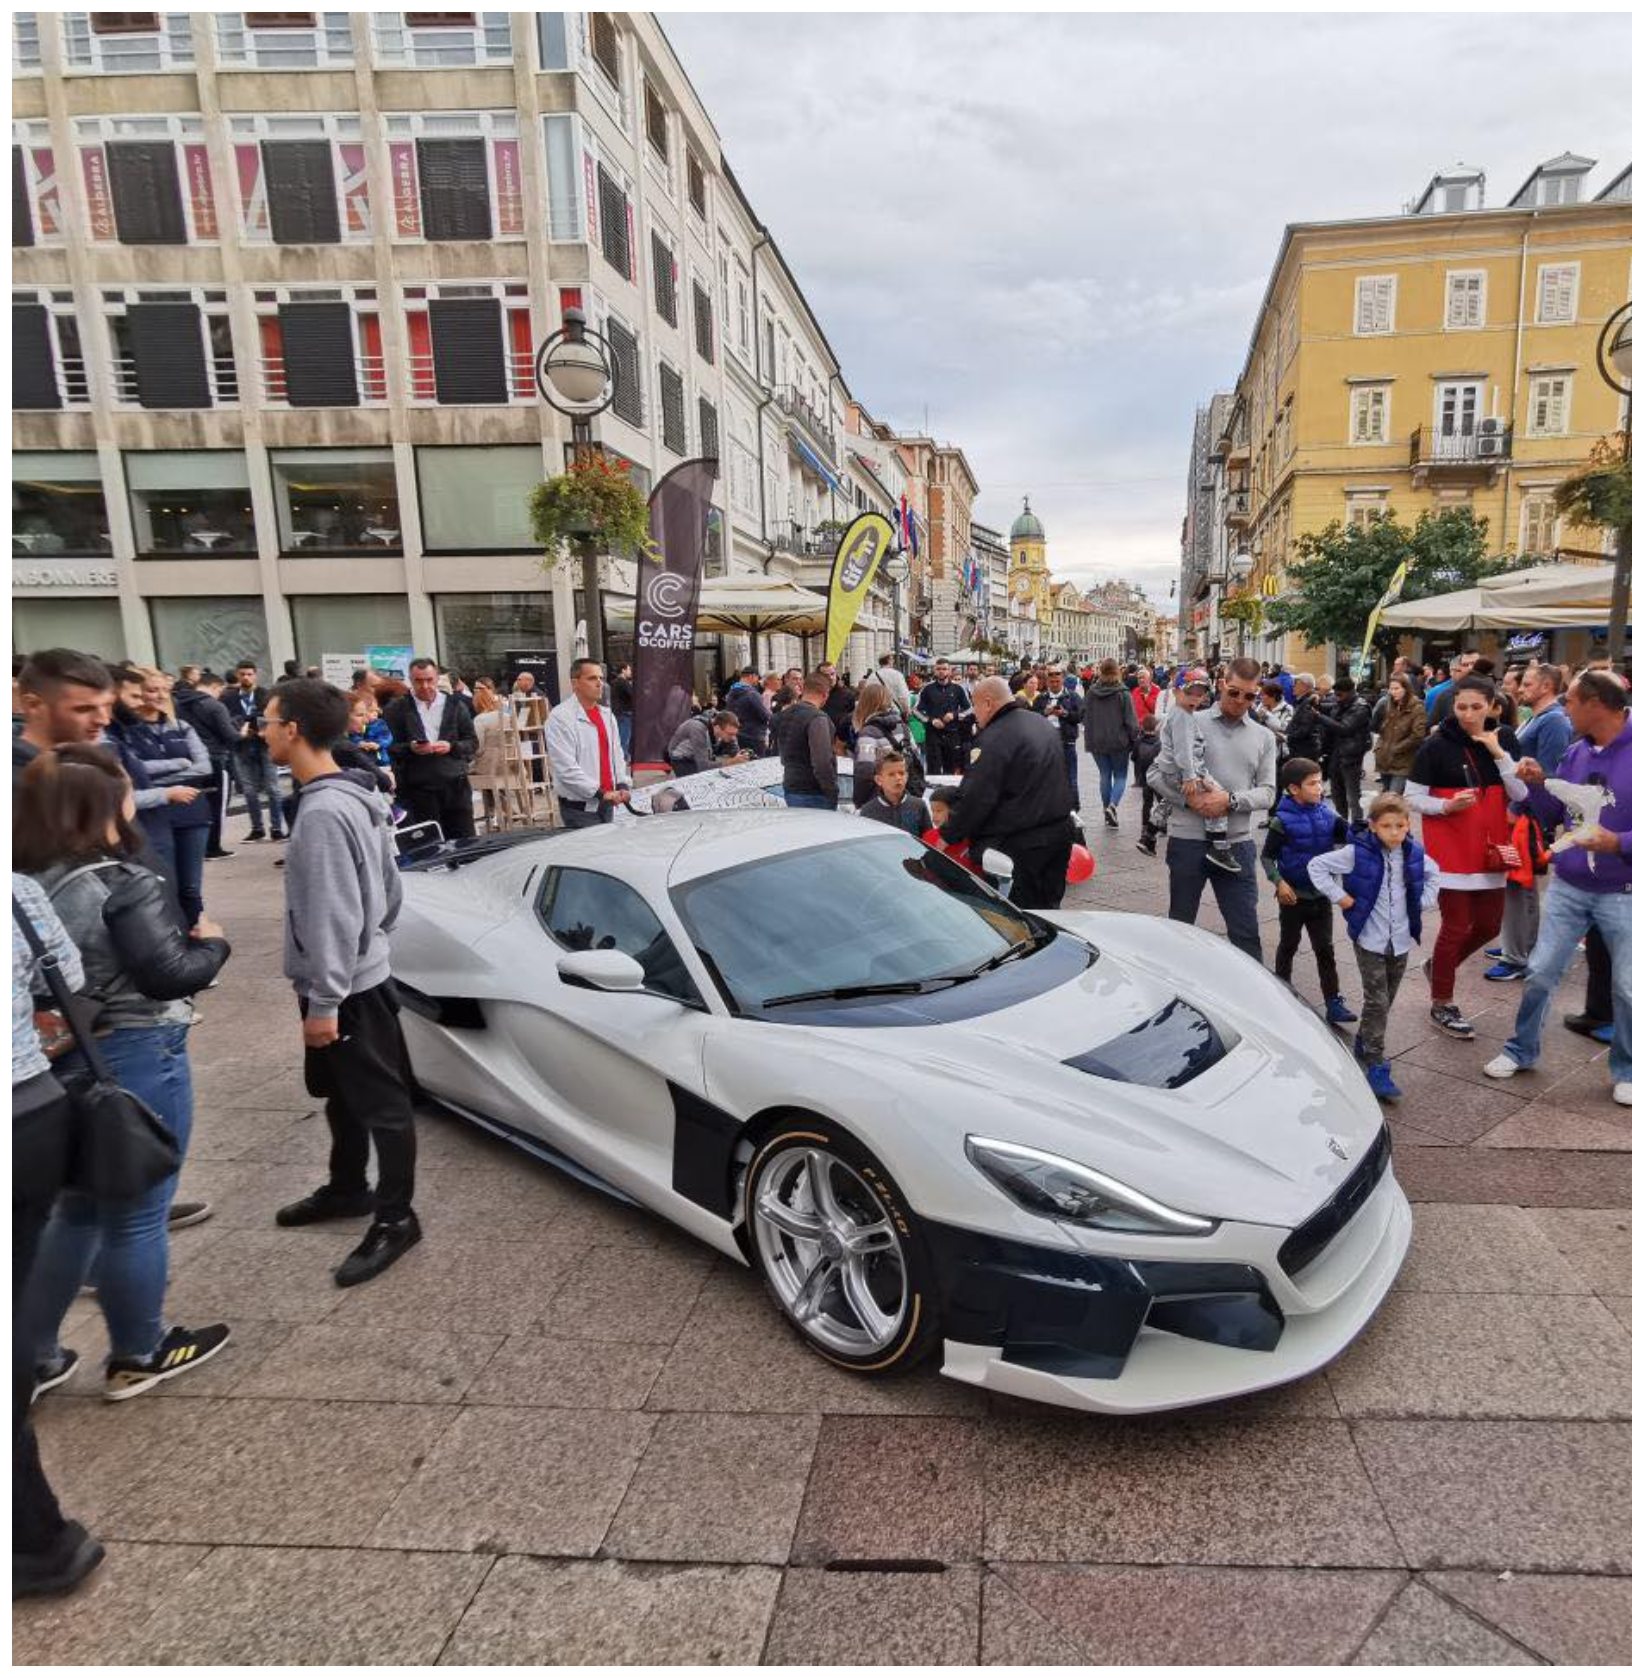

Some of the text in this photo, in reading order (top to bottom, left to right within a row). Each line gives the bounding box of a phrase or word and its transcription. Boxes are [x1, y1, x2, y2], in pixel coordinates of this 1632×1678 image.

[90, 155, 108, 215] ALGEBRA
[400, 152, 414, 212] ALGEBRA
[639, 621, 692, 640] CARS
